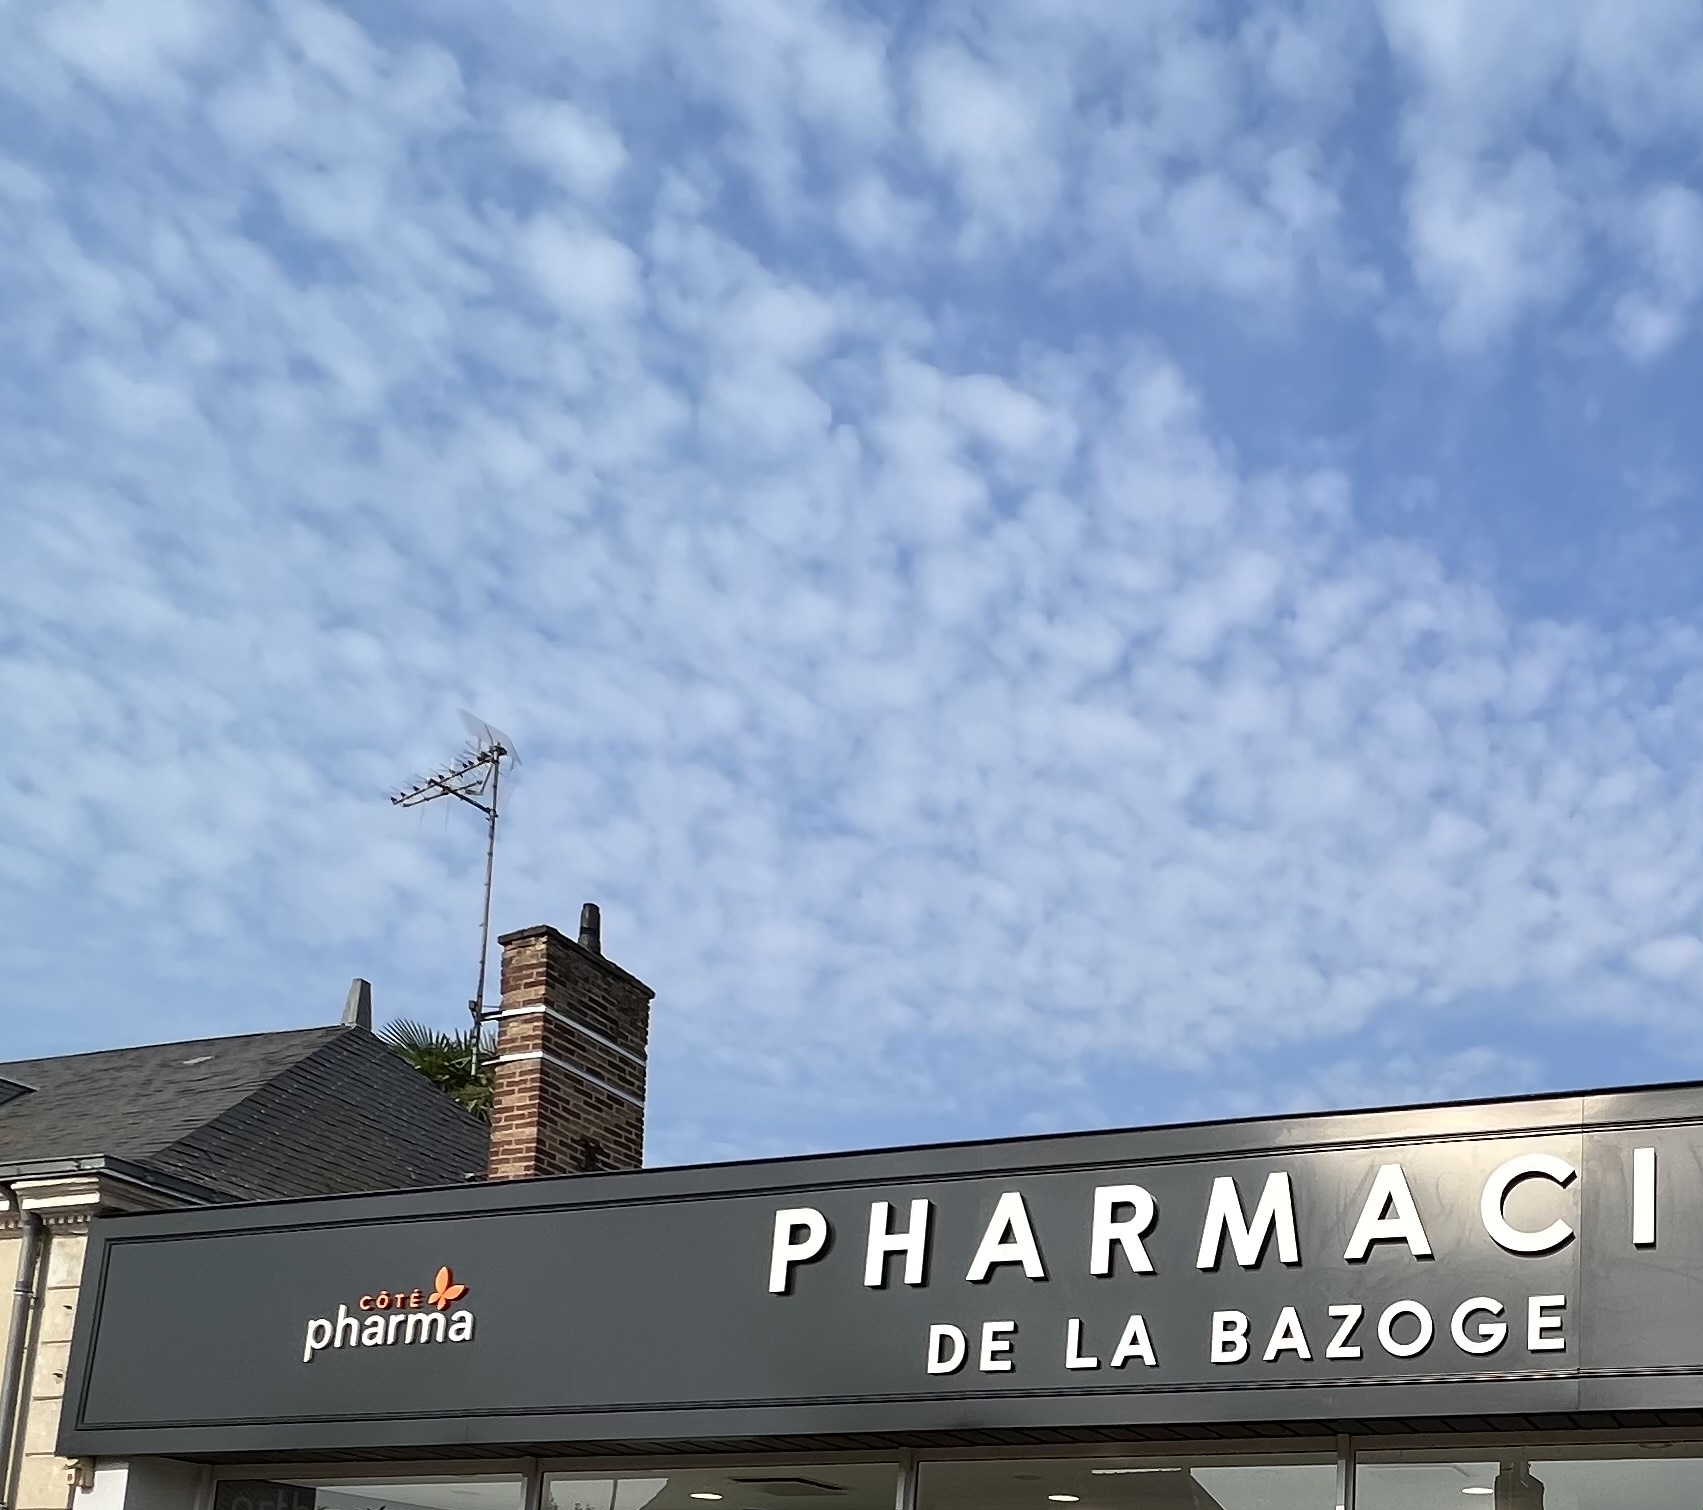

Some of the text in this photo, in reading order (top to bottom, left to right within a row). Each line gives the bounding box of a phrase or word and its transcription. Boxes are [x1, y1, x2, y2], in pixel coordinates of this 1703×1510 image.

[359, 1288, 424, 1311] CÔTÉ
[303, 1304, 475, 1363] pharma
[927, 1294, 1567, 1375] DE LA BAZOGE
